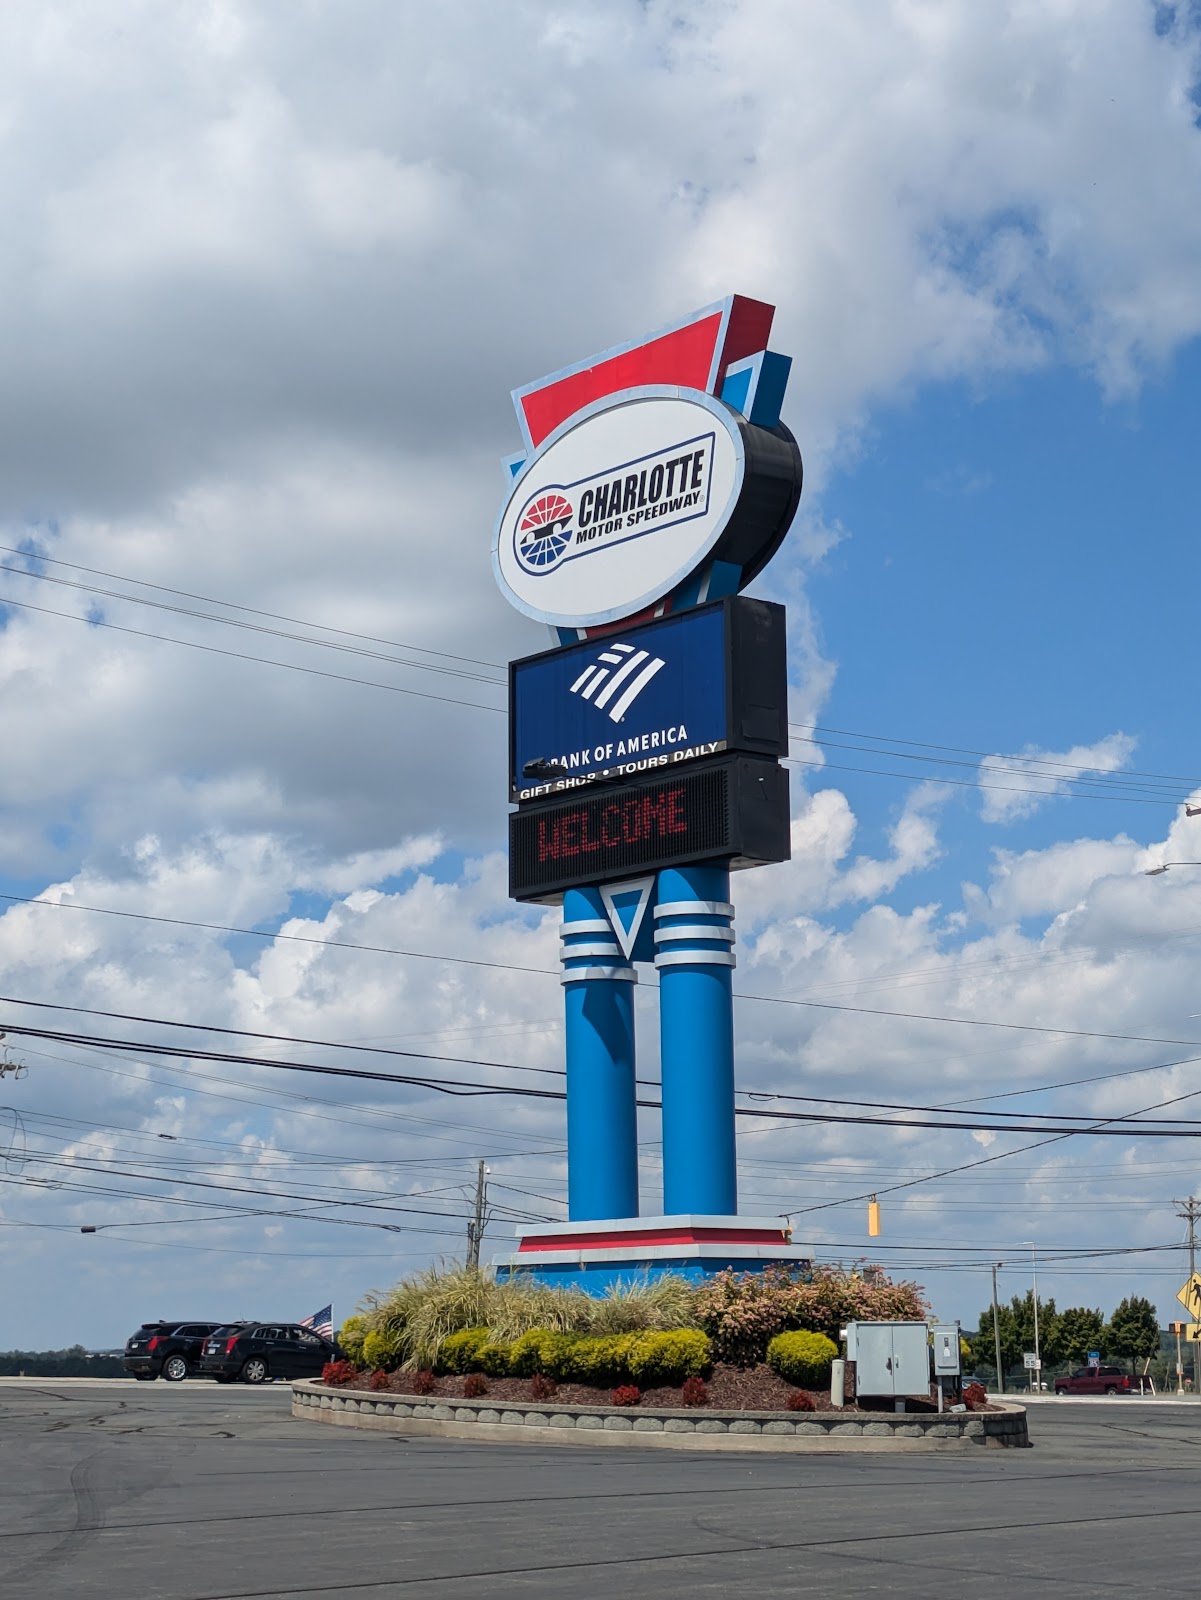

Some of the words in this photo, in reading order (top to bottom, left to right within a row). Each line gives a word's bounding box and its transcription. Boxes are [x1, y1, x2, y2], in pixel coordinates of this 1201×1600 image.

[578, 449, 705, 528] CHARLOTTE
[576, 515, 623, 545] MOTOR
[520, 783, 551, 800] GIFT
[556, 771, 597, 791] SHOP
[617, 754, 668, 774] TOURS
[674, 741, 719, 762] DAILY
[595, 743, 614, 762] OF
[617, 725, 688, 757] AMERICA
[538, 788, 688, 862] WELCOME
